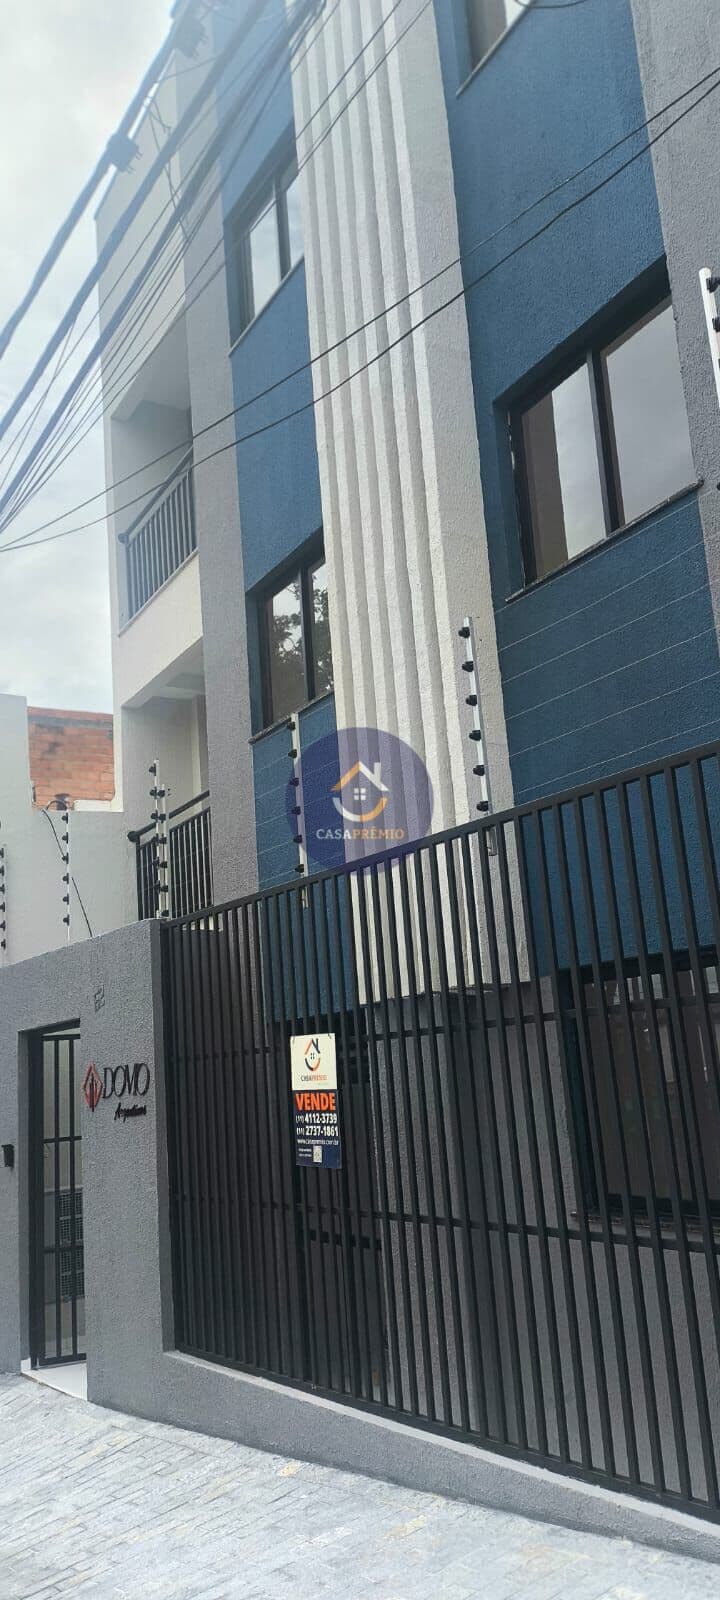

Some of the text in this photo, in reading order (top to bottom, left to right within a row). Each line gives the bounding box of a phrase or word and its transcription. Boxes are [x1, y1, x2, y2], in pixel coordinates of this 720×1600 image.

[102, 1063, 150, 1098] DOMO
[295, 1092, 336, 1111] VENDE
[304, 1112, 338, 1124] 4112-3739
[305, 1125, 339, 1137] 2737-1861
